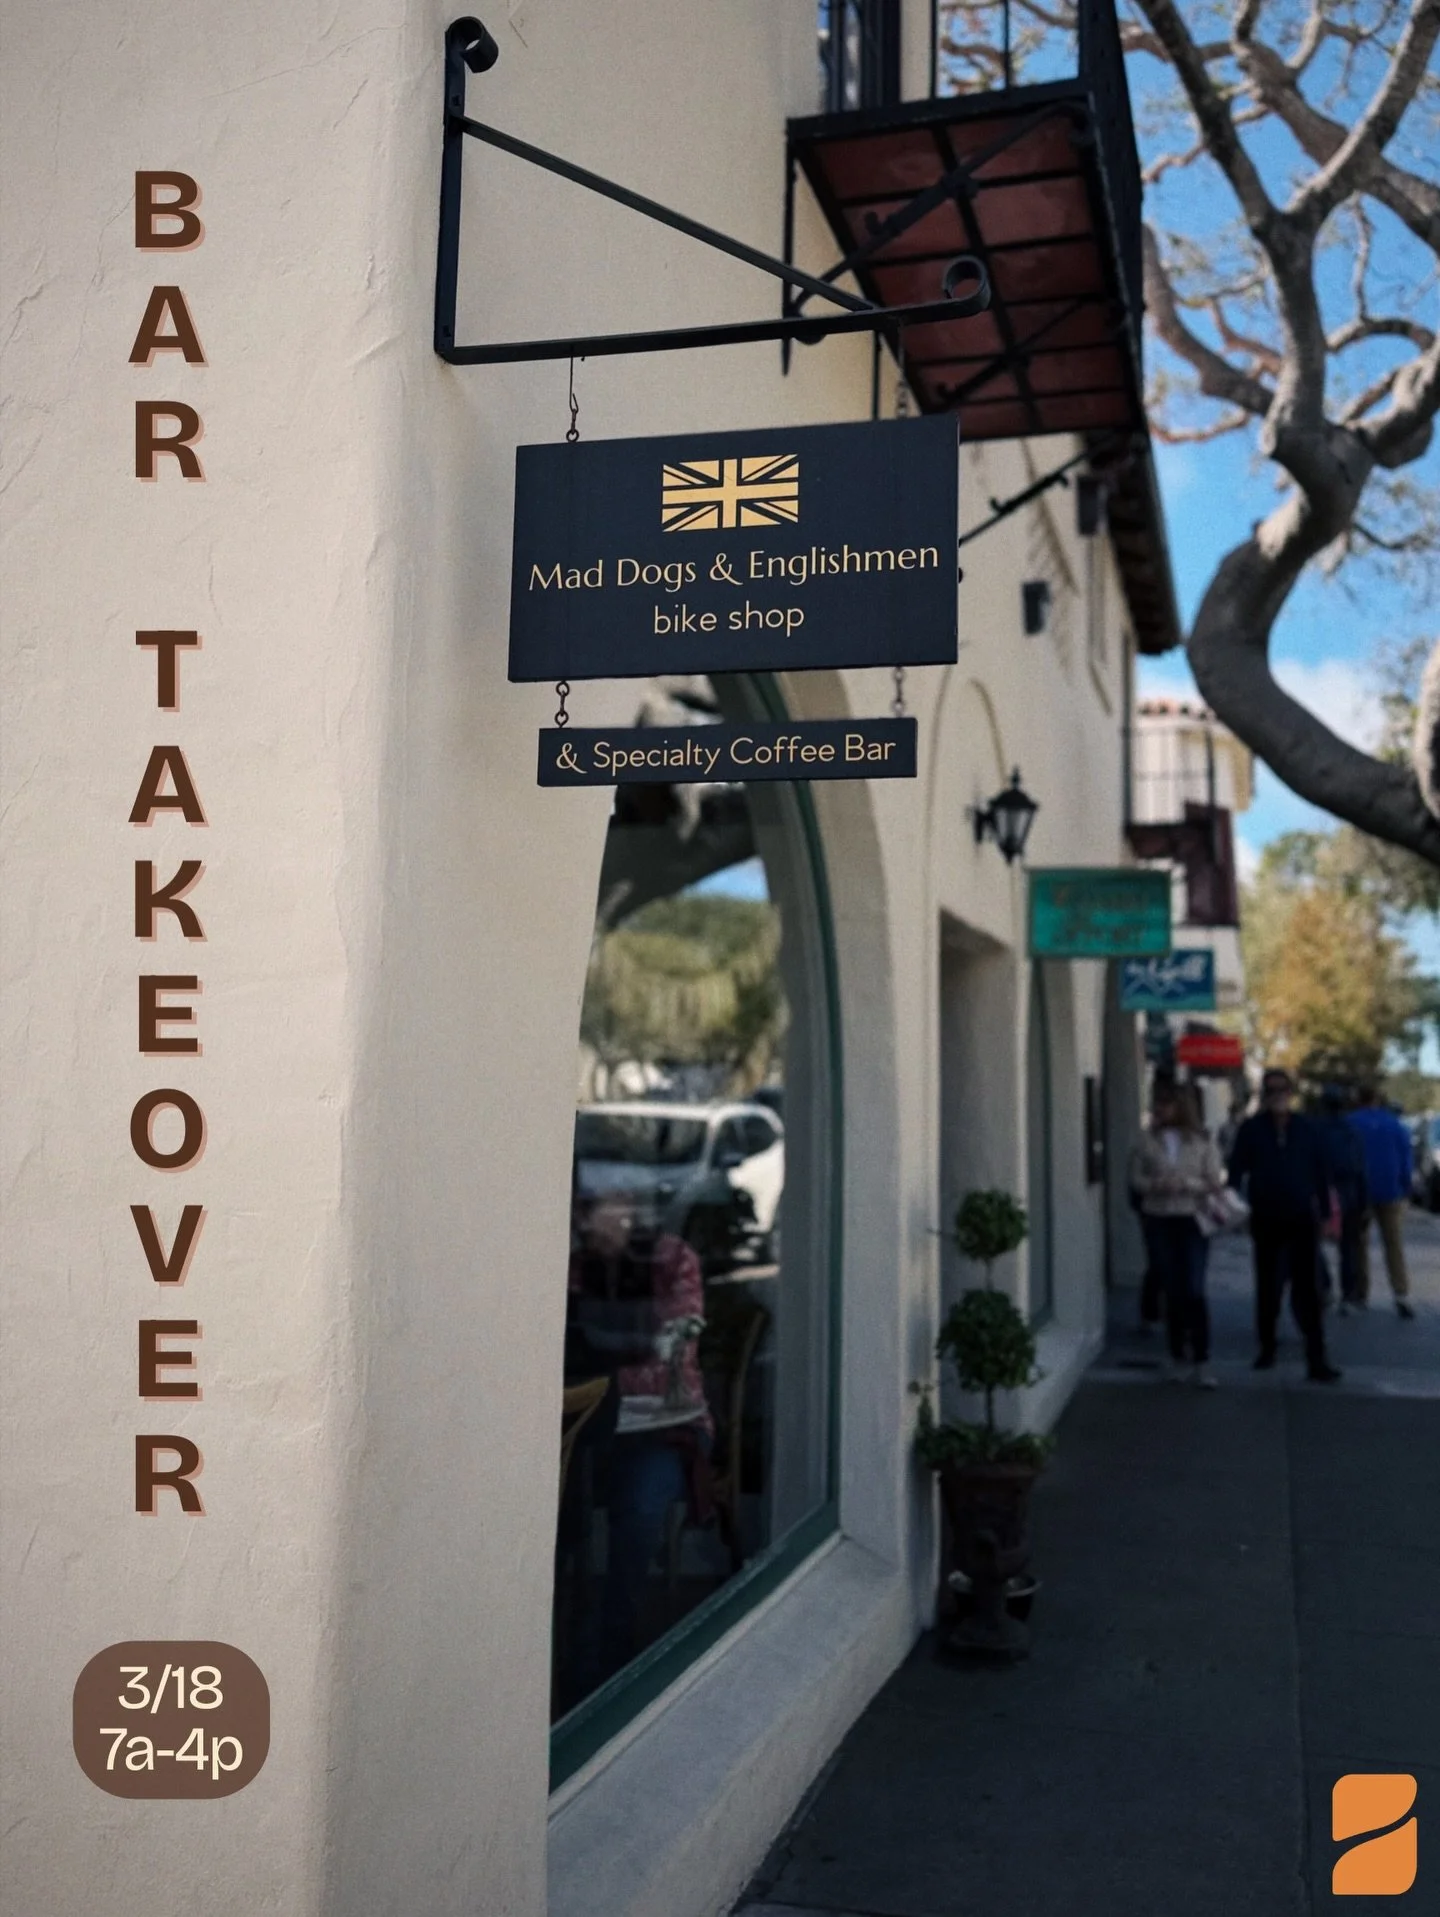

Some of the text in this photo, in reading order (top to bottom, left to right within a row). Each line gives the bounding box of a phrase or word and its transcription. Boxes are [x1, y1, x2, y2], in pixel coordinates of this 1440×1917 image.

[529, 544, 939, 593] Mad Dogs & Englishmen
[654, 601, 805, 637] bike shop
[556, 733, 896, 776] & Specialty Coffee Bar
